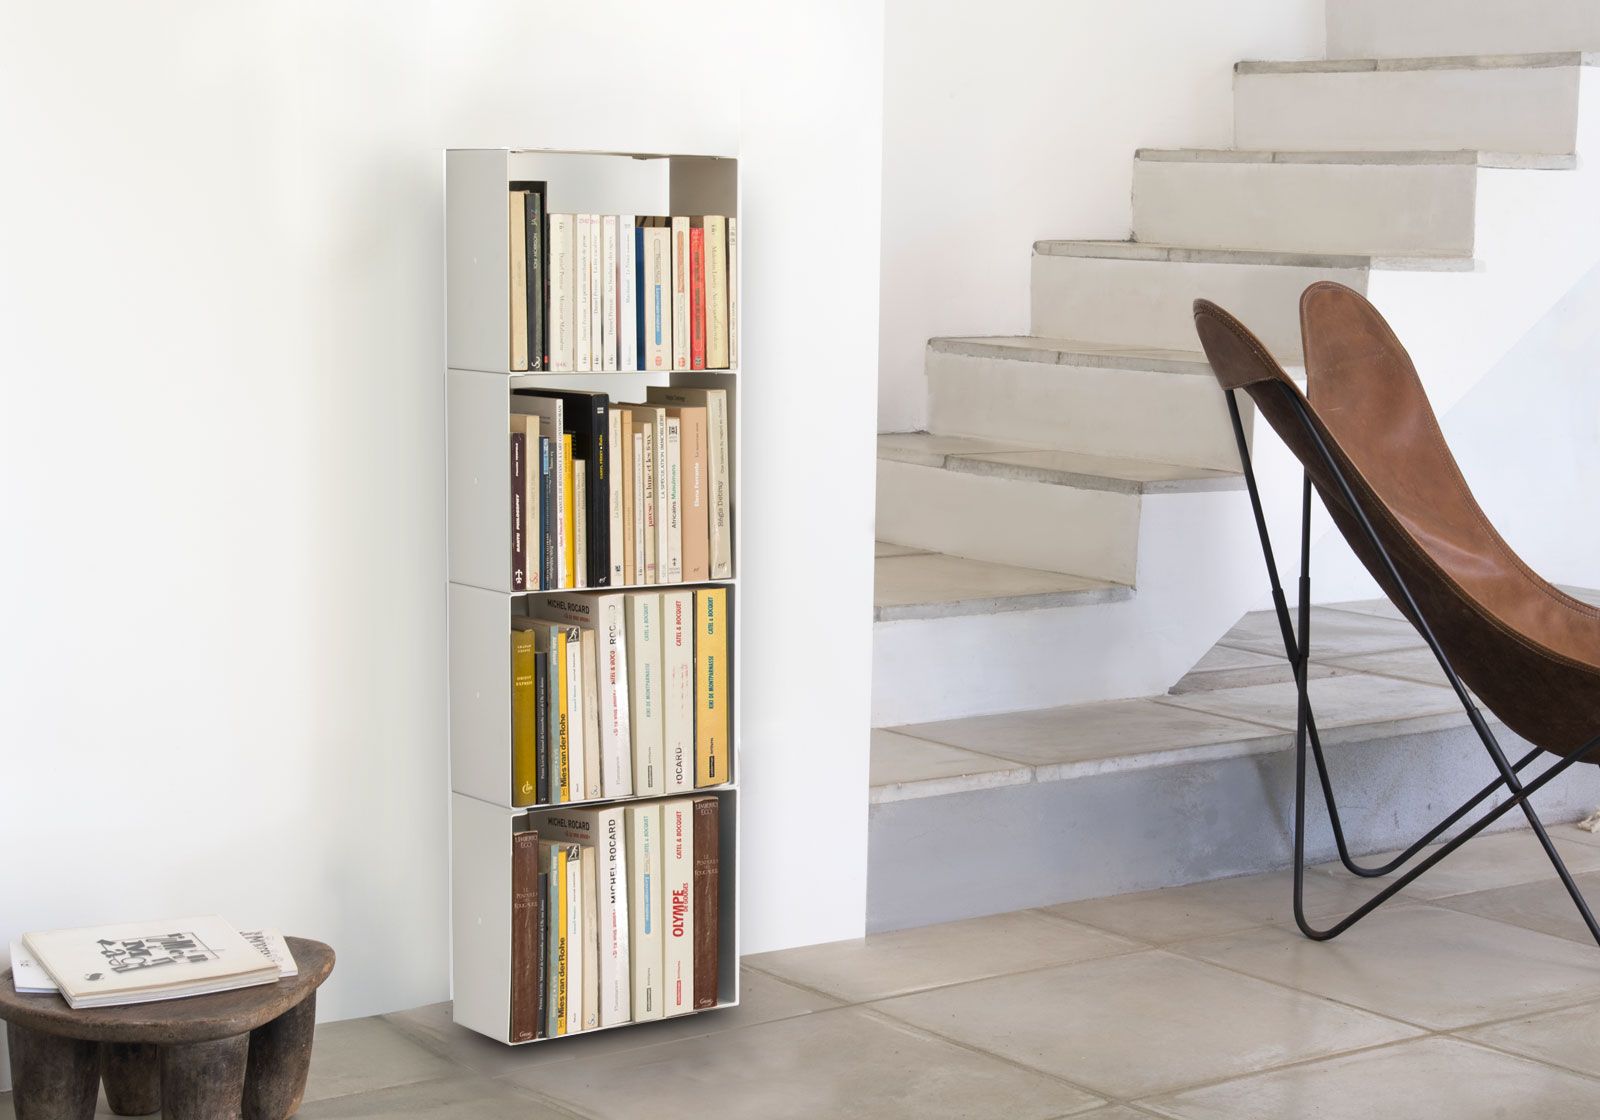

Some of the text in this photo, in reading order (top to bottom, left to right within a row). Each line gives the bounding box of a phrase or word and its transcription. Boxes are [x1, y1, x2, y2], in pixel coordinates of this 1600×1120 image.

[567, 602, 590, 615] ROCARD
[568, 819, 590, 831] ROCARD
[609, 819, 617, 862] ROCARD
[672, 890, 685, 938] OLYMPE
